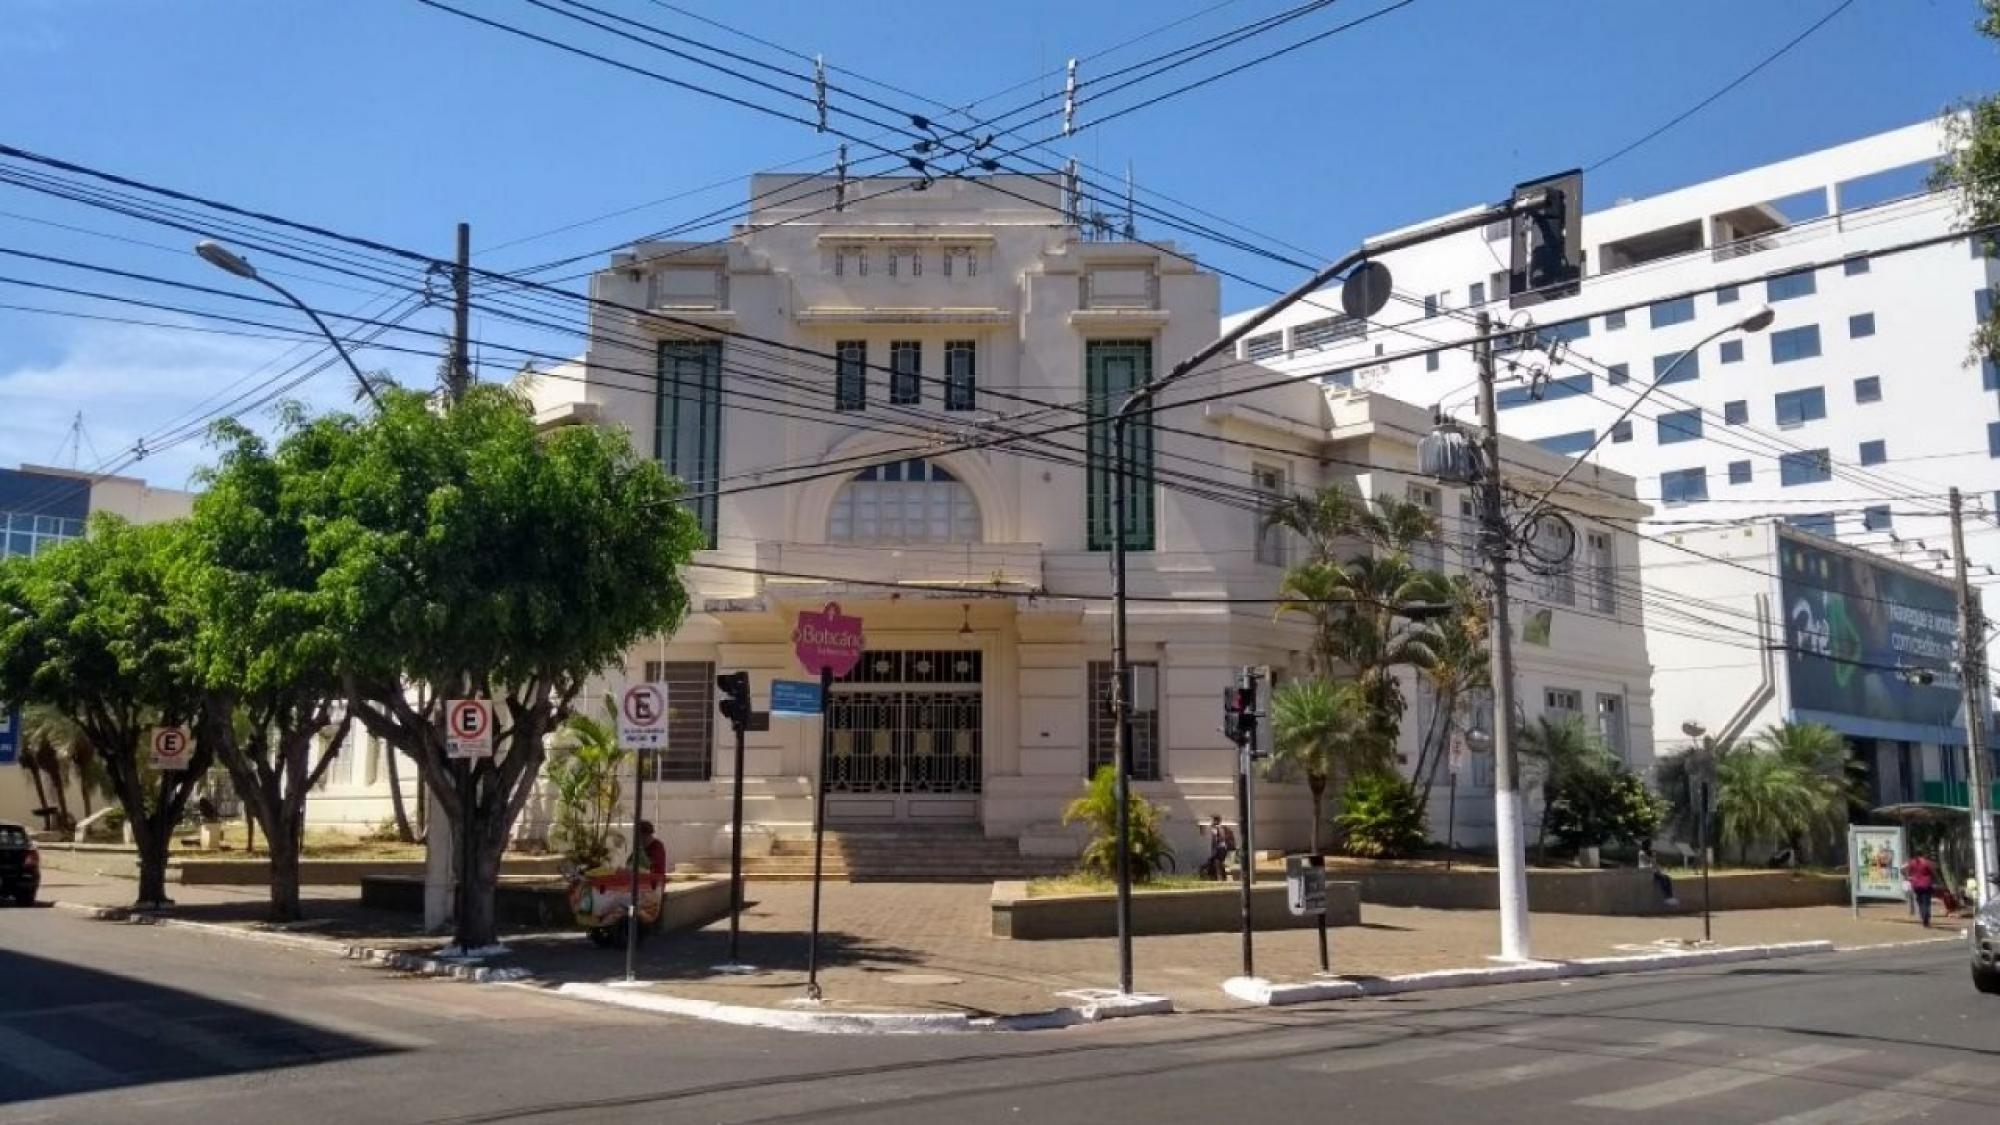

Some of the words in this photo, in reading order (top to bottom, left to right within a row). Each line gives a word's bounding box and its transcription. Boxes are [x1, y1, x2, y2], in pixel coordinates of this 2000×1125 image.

[635, 692, 651, 719] E
[463, 708, 477, 731] E
[164, 735, 176, 751] E
